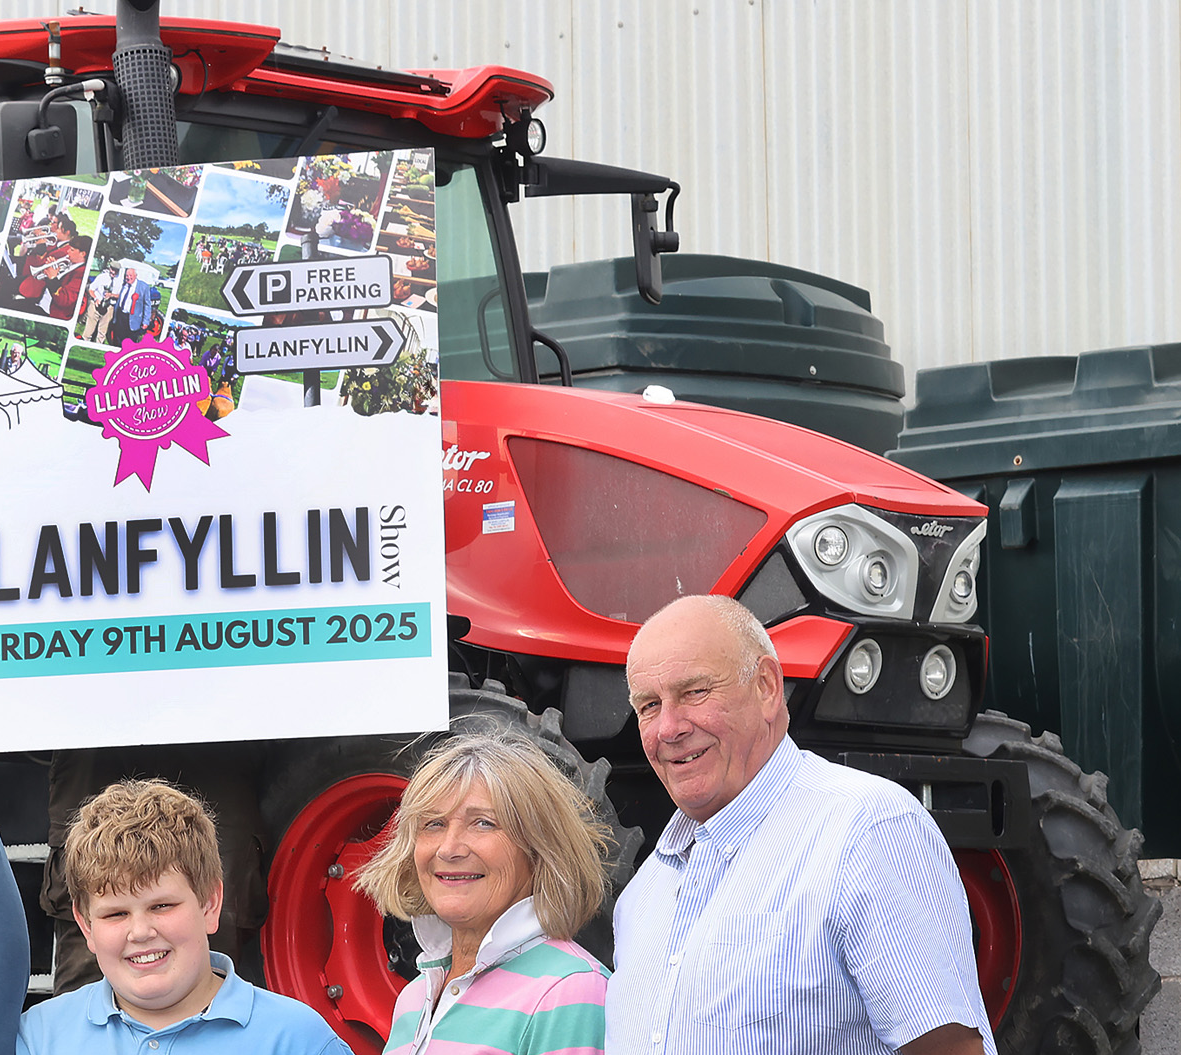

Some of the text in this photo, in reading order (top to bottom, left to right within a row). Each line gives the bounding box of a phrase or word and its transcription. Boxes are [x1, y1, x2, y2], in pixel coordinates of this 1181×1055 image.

[307, 267, 356, 284] FREE
[266, 273, 287, 302] P
[295, 284, 382, 303] PARKING
[244, 335, 369, 360] LLANFYLLIN
[129, 364, 157, 383] Sioe
[94, 373, 201, 413] LLANFYLLIN
[133, 404, 169, 426] Show
[457, 479, 473, 493] CL
[474, 480, 494, 494] 80
[379, 504, 407, 590] Show
[102, 624, 165, 656] 9TH
[175, 616, 316, 652] AUGUST
[326, 611, 418, 645] 2025
